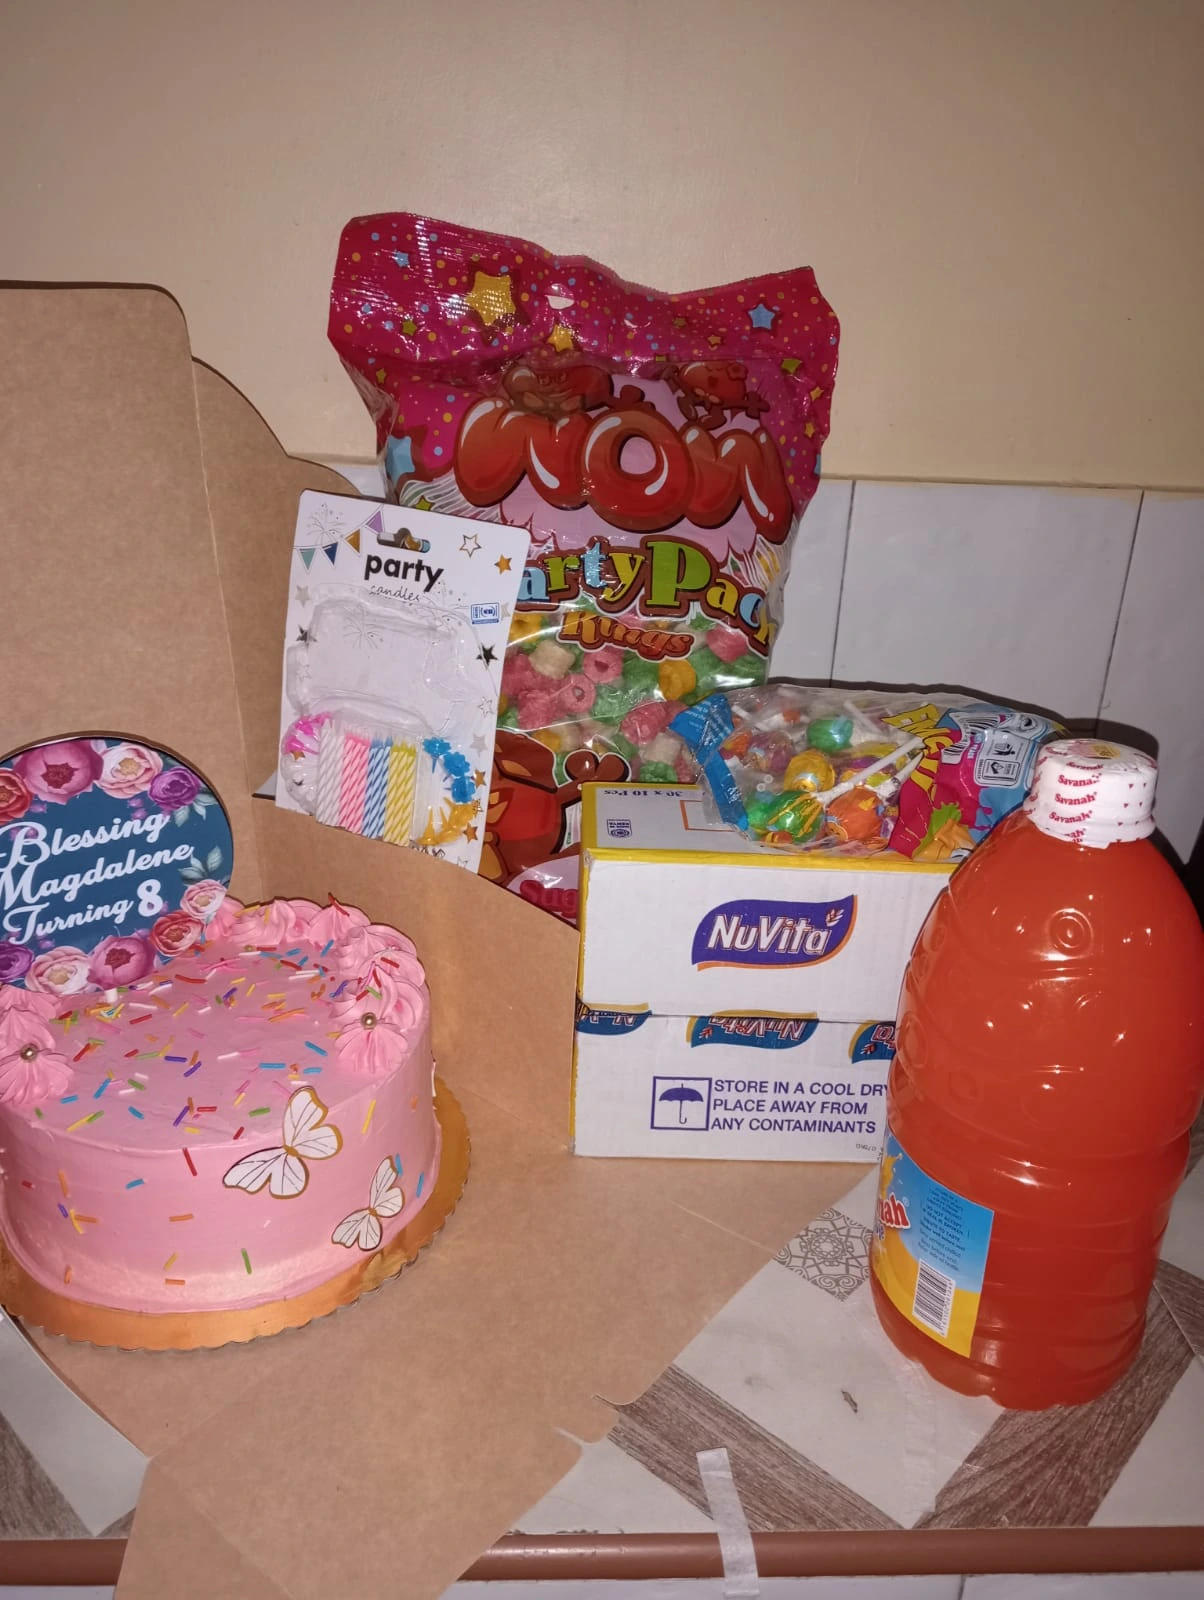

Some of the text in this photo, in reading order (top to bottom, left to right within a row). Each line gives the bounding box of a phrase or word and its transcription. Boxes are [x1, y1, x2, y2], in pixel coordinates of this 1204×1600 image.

[364, 554, 445, 593] party
[517, 542, 646, 602] arty
[368, 585, 422, 604] candles
[560, 612, 692, 655] Rings
[1057, 774, 1101, 787] Savana
[1054, 793, 1096, 806] Savanah
[1048, 811, 1091, 824] Savanah
[0, 813, 170, 872] Blessing
[0, 843, 194, 909] Magdalene
[3, 878, 163, 945] Turning 8
[707, 914, 832, 955] NuVita
[714, 1080, 768, 1093] STORE
[773, 1082, 789, 1094] IN
[793, 1082, 805, 1095] A
[809, 1083, 855, 1096] COOL
[712, 1099, 868, 1115] PLACE AWAY FROM
[710, 1117, 876, 1134] ANY CONTAMINANTS
